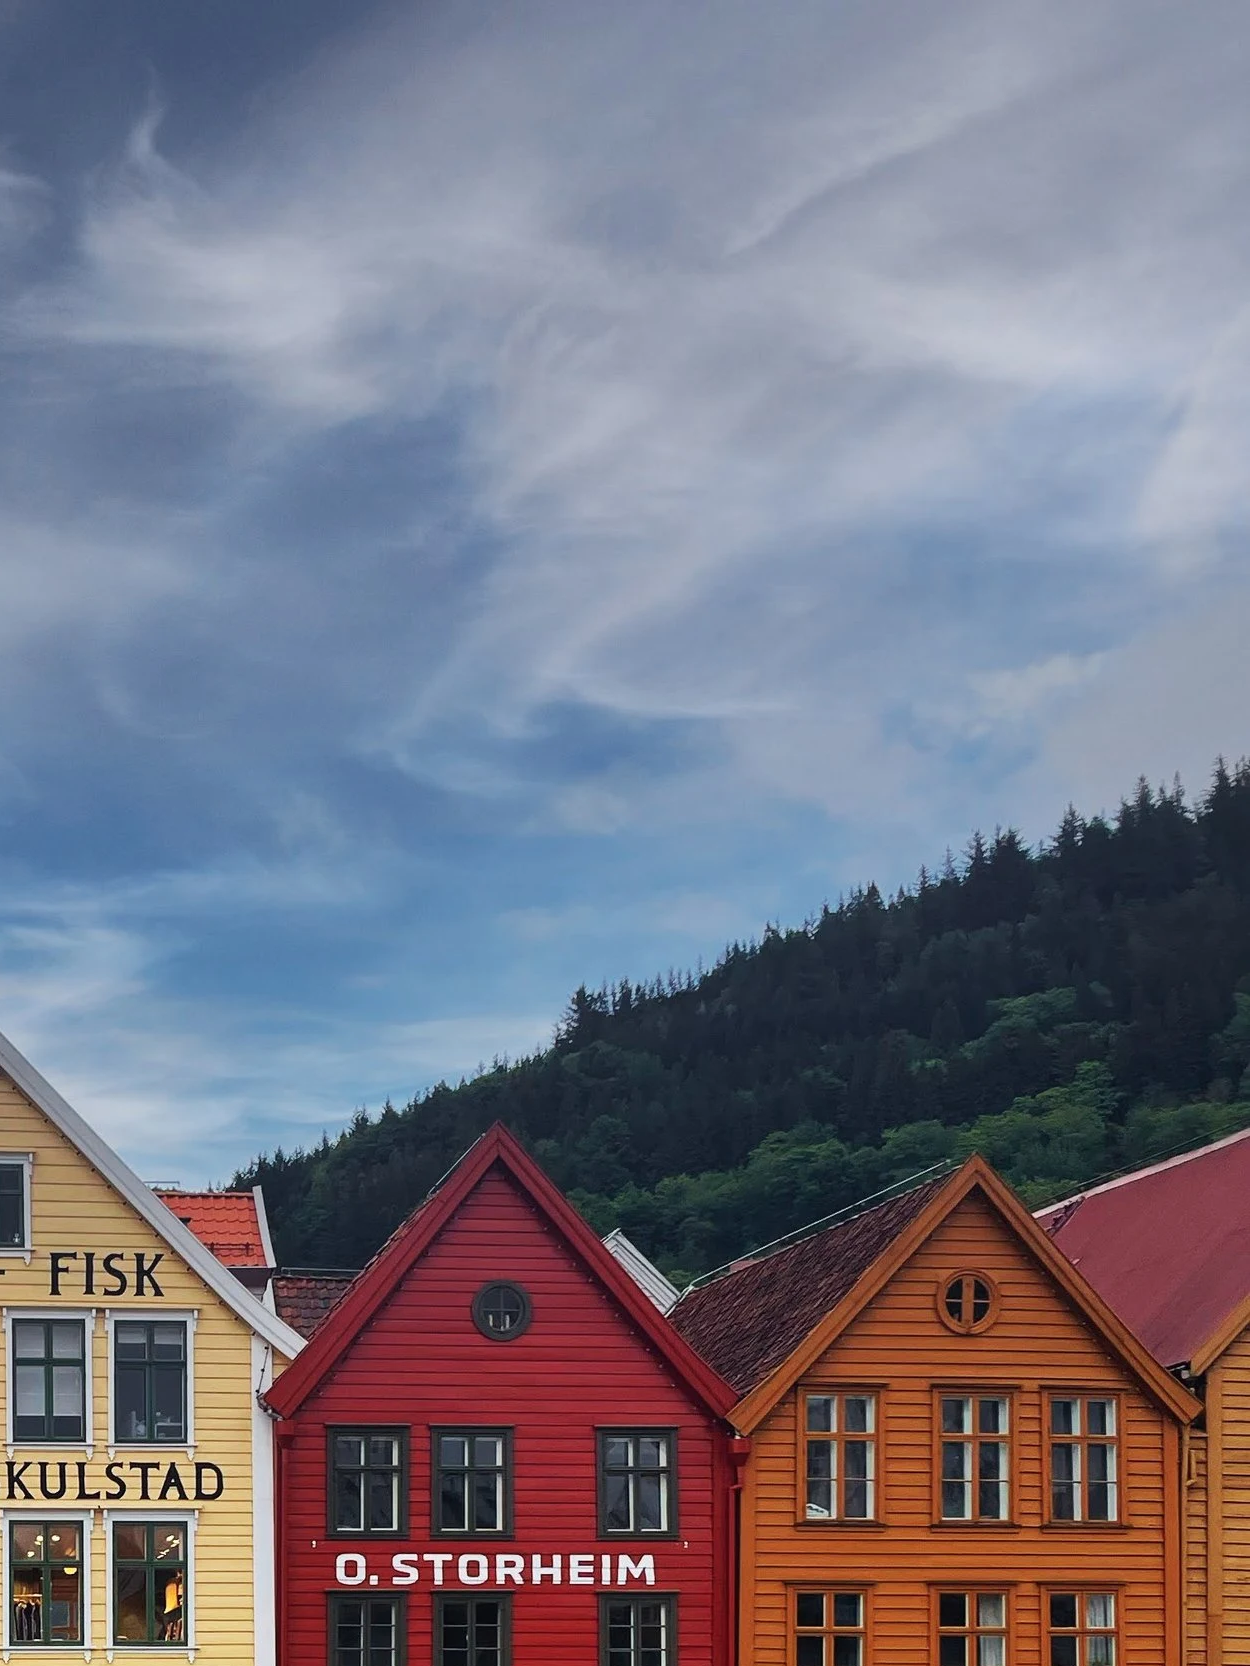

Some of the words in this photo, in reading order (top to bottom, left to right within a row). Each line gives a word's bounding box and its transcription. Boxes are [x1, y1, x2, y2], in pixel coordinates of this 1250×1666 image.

[49, 1251, 165, 1297] FISK
[335, 1553, 379, 1585] O.
[392, 1553, 656, 1586] STORHEIM
